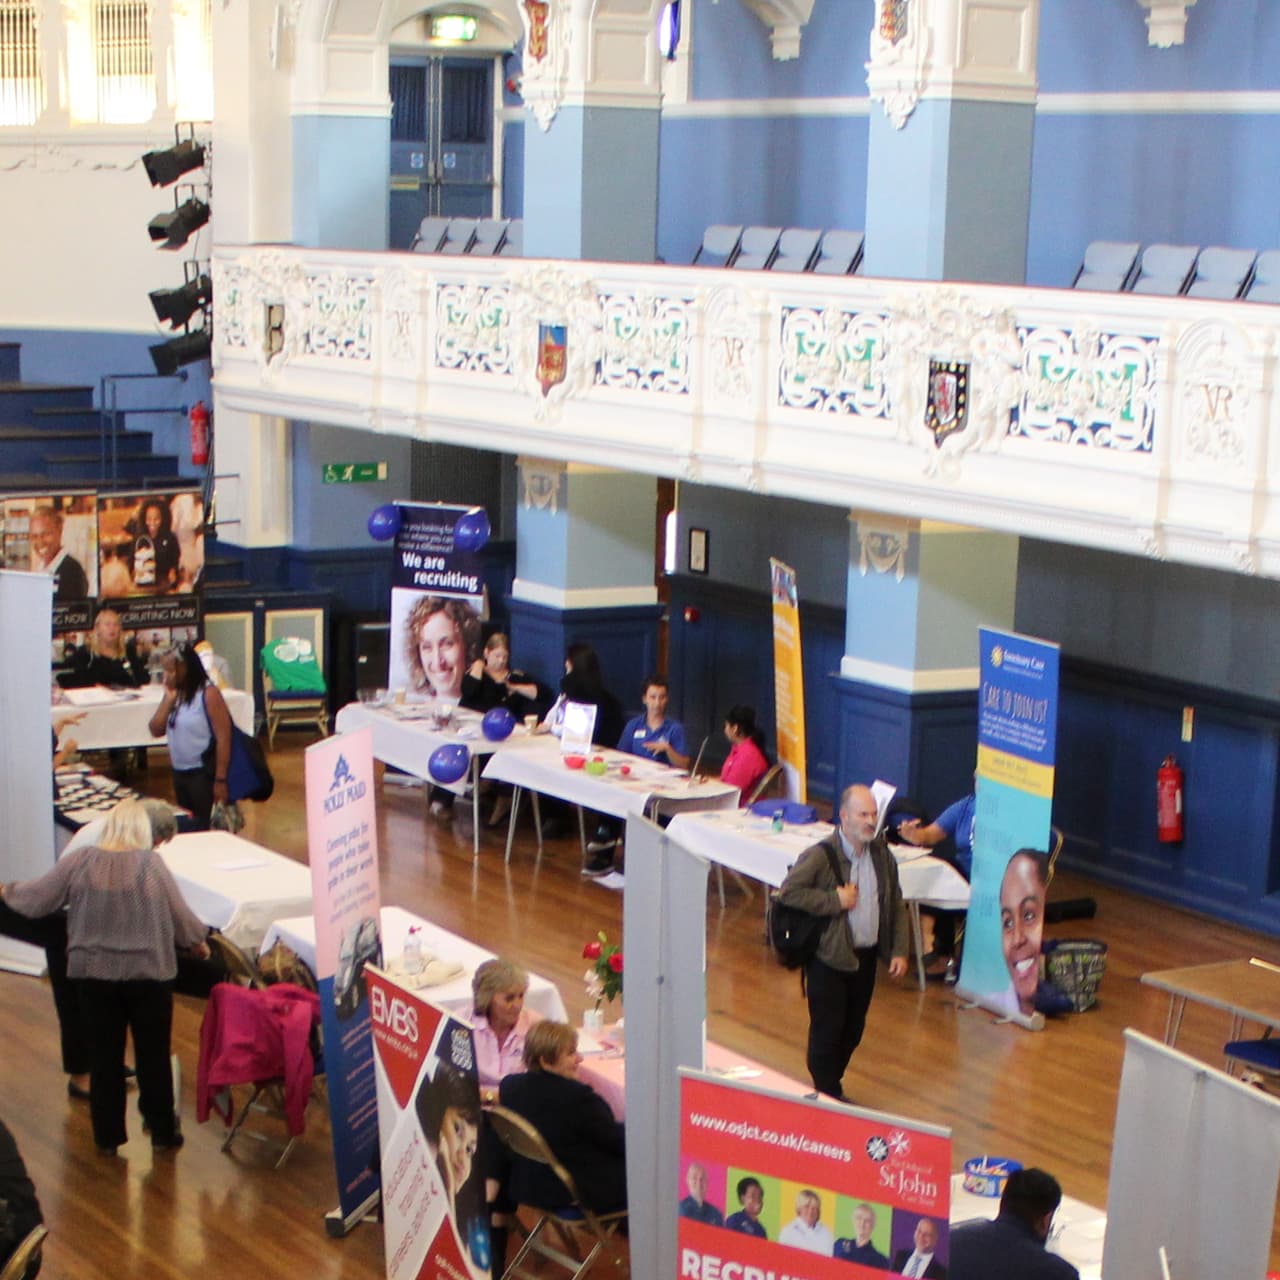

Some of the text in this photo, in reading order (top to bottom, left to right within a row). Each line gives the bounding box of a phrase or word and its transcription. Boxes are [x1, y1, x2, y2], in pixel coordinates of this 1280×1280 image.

[402, 551, 445, 571] We are
[414, 570, 478, 593] recruiting
[64, 612, 88, 625] NOW
[371, 984, 420, 1043] EMBS
[689, 1111, 852, 1163] www.osjct.co.uk/careers
[898, 1169, 937, 1199] John
